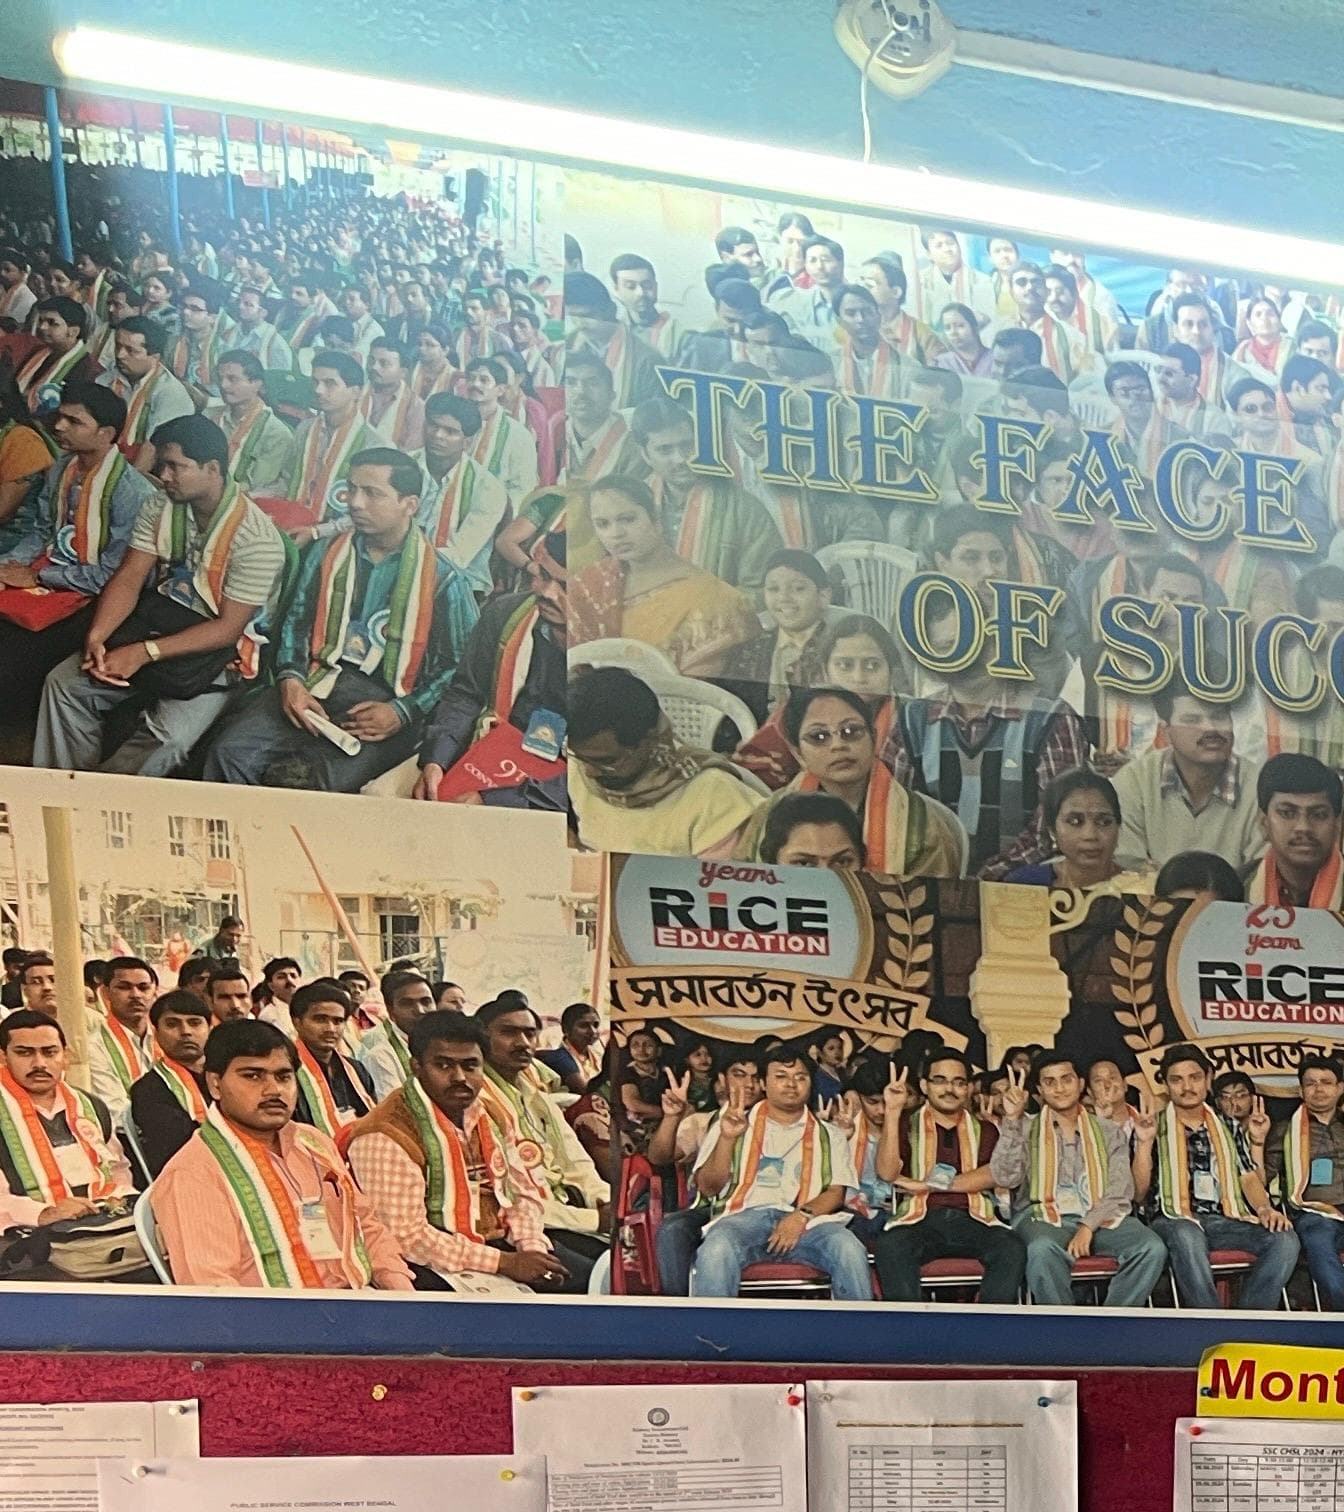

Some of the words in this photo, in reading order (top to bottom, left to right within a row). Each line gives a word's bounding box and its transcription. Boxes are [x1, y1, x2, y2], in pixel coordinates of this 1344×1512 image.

[655, 364, 939, 504] THE
[977, 410, 1318, 555] FACE
[898, 570, 1062, 682] OF
[657, 927, 827, 953] EDUCATION
[627, 972, 795, 1010] সমাবর্তন
[803, 978, 919, 1030] উৎসব
